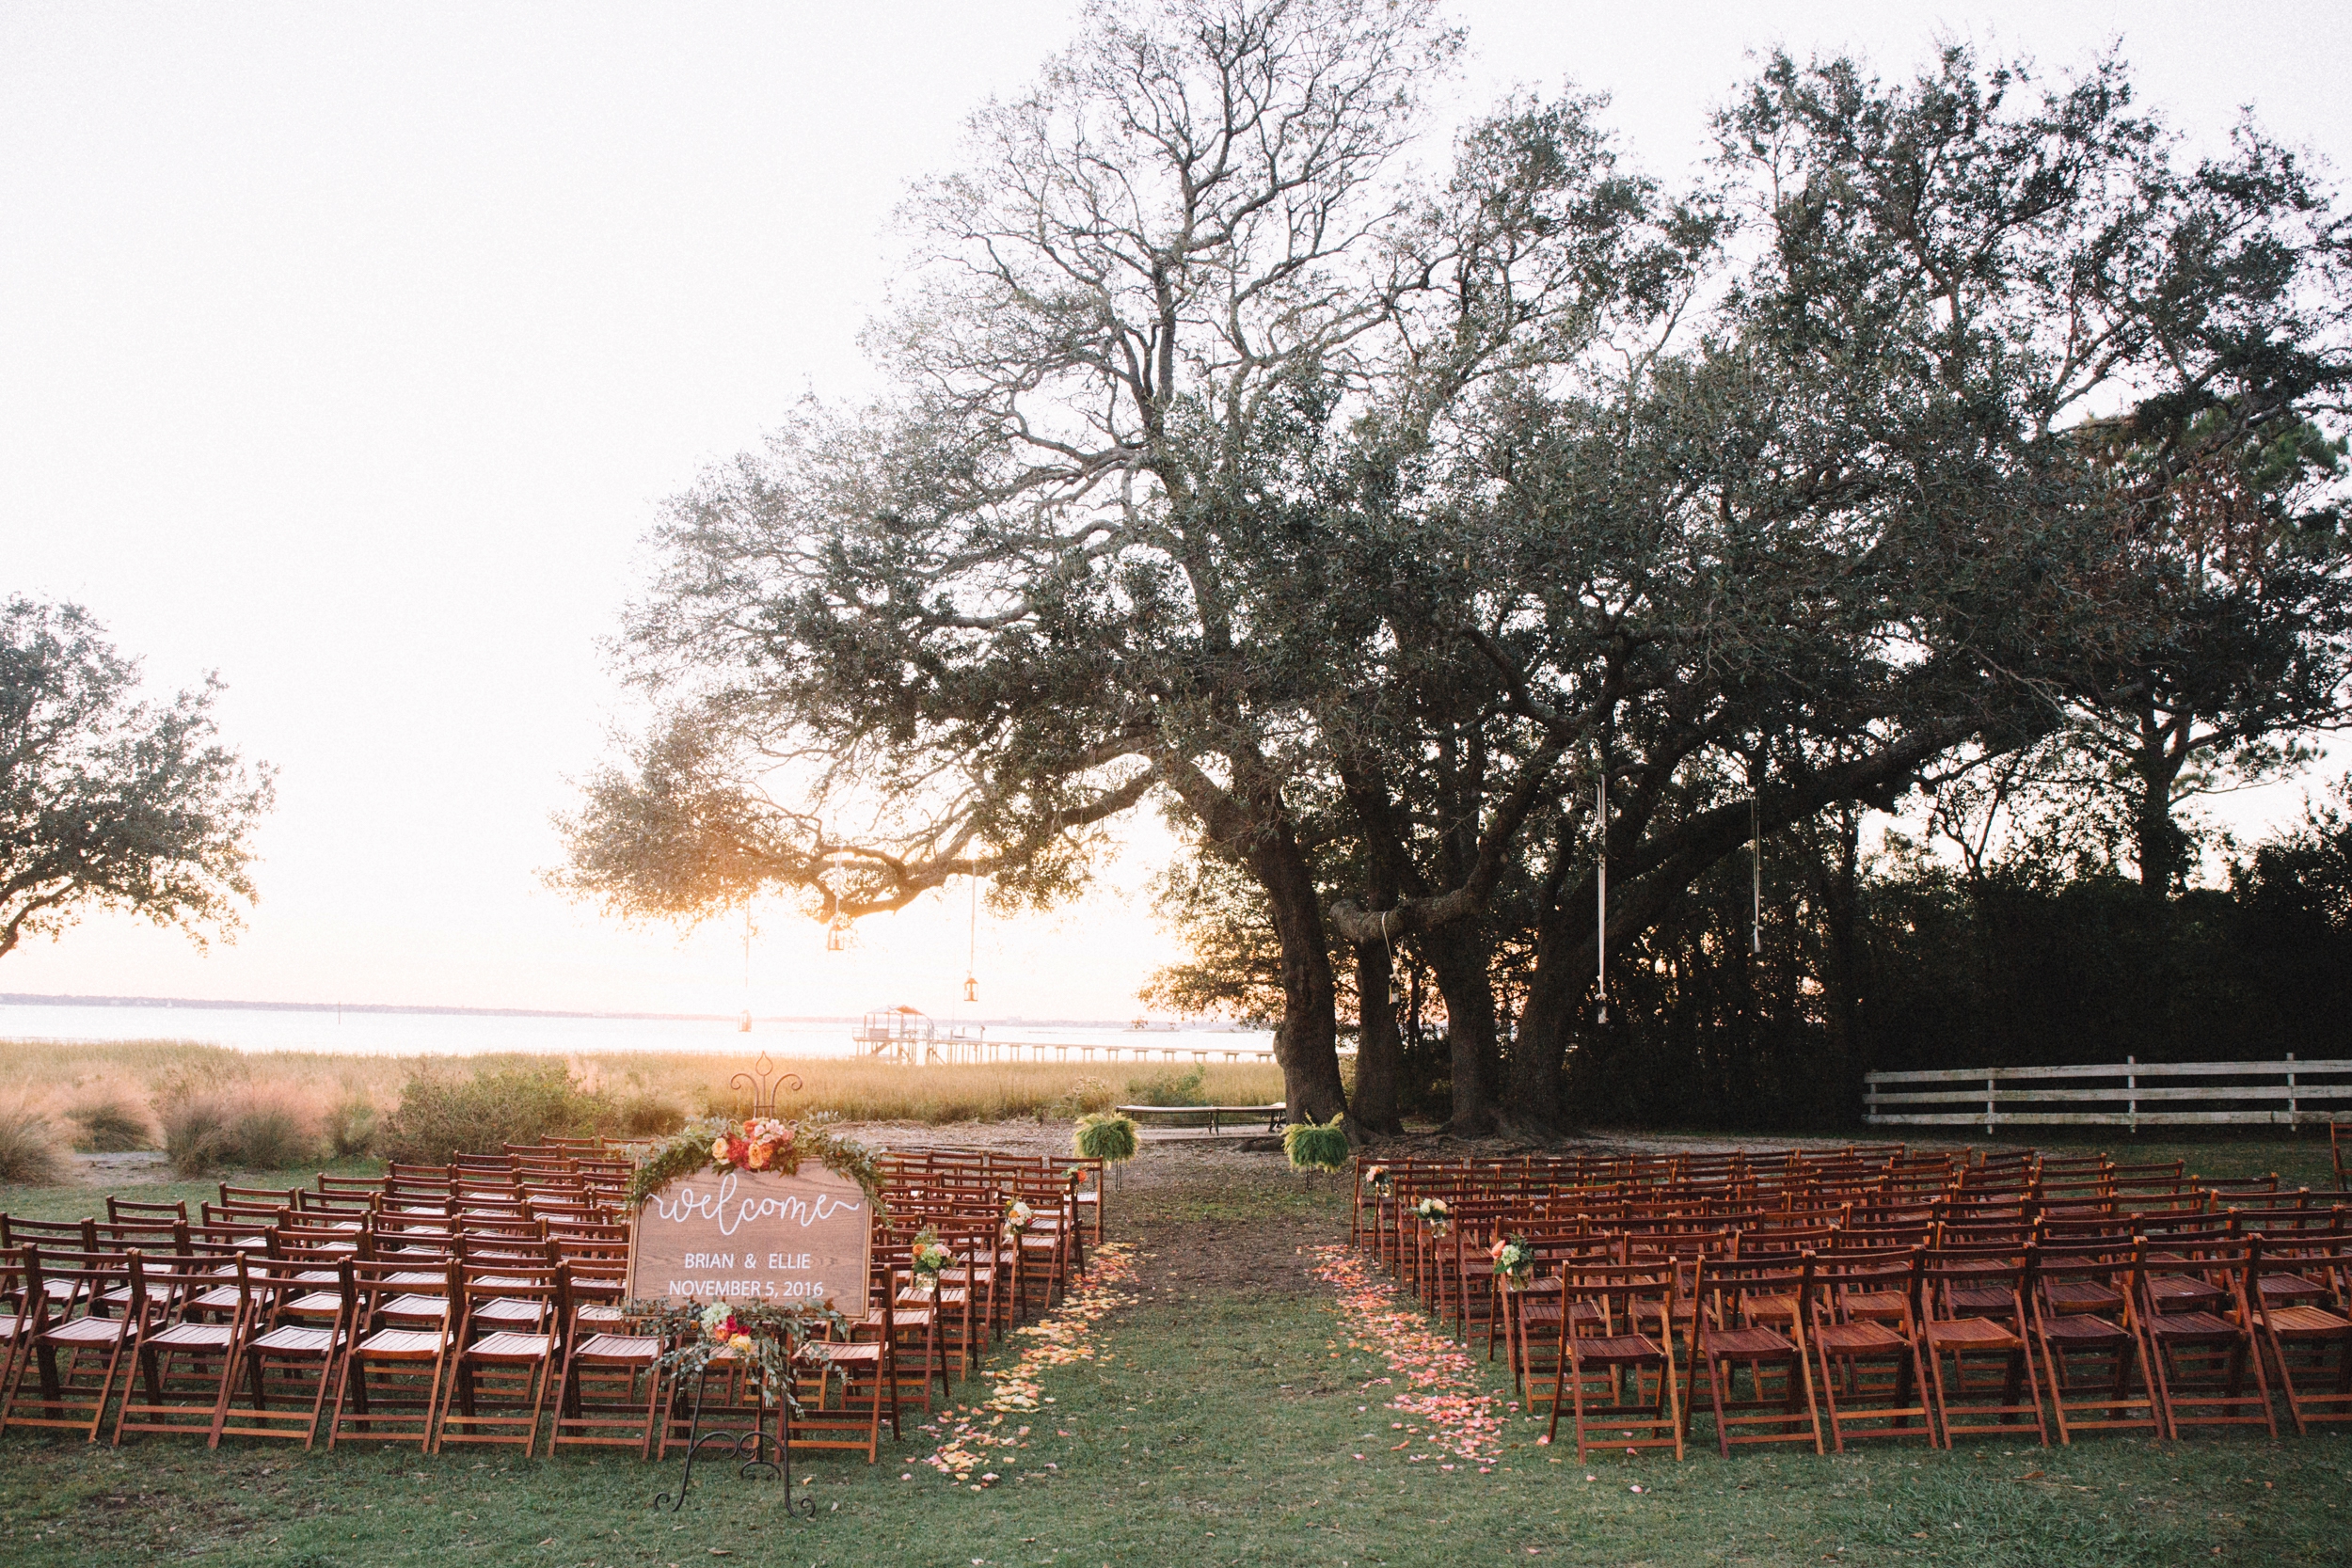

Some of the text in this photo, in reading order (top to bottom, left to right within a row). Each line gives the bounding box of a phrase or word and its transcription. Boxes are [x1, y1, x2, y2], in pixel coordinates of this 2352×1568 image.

[645, 1173, 859, 1236] welcome
[685, 1253, 811, 1269] BRIAN & ELLIE
[669, 1280, 824, 1298] NOVEMBER 5, 2016
